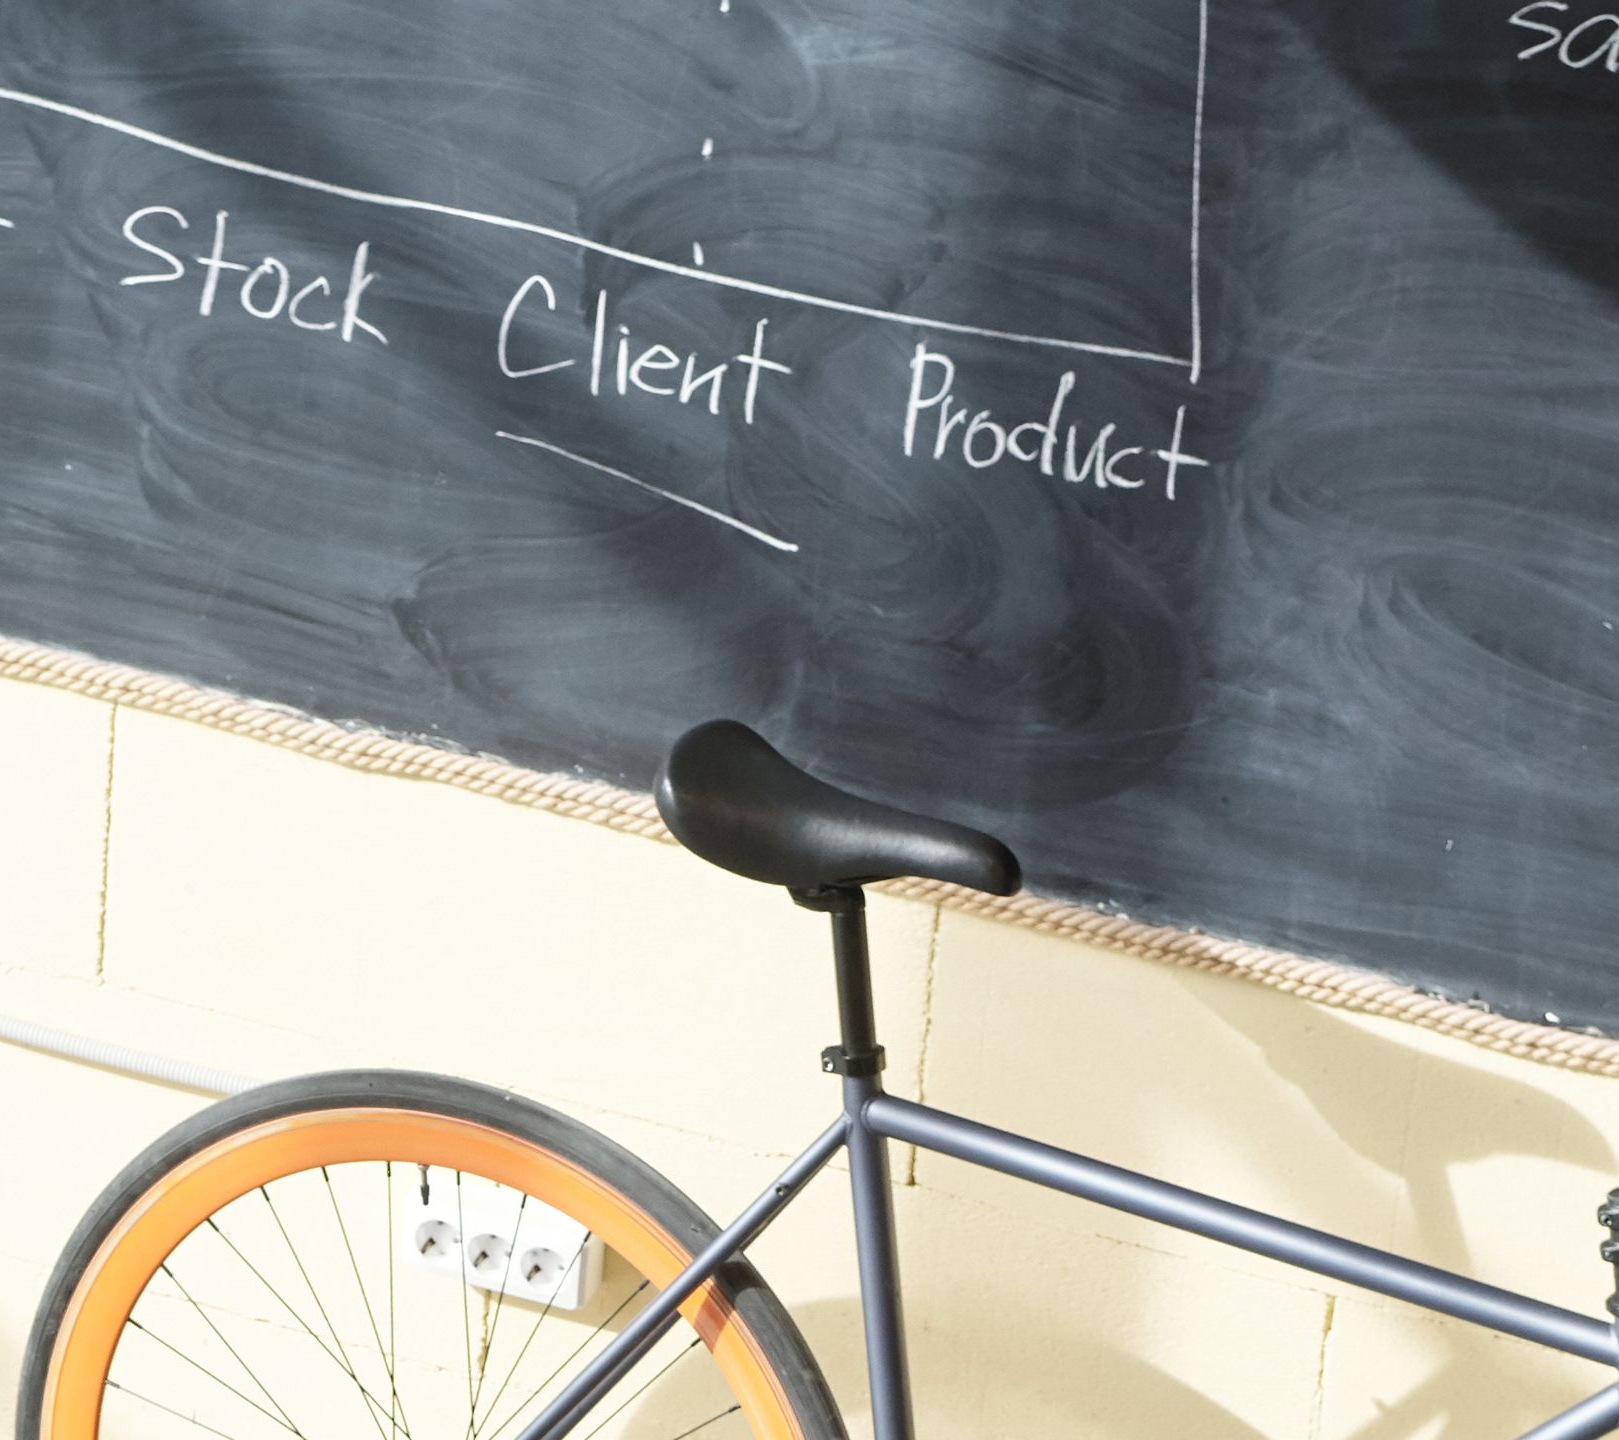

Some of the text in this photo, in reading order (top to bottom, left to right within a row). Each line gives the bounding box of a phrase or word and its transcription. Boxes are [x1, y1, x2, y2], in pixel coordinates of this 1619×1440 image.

[120, 205, 387, 344] Stock
[497, 274, 792, 425] Client
[902, 343, 1210, 501] Product
